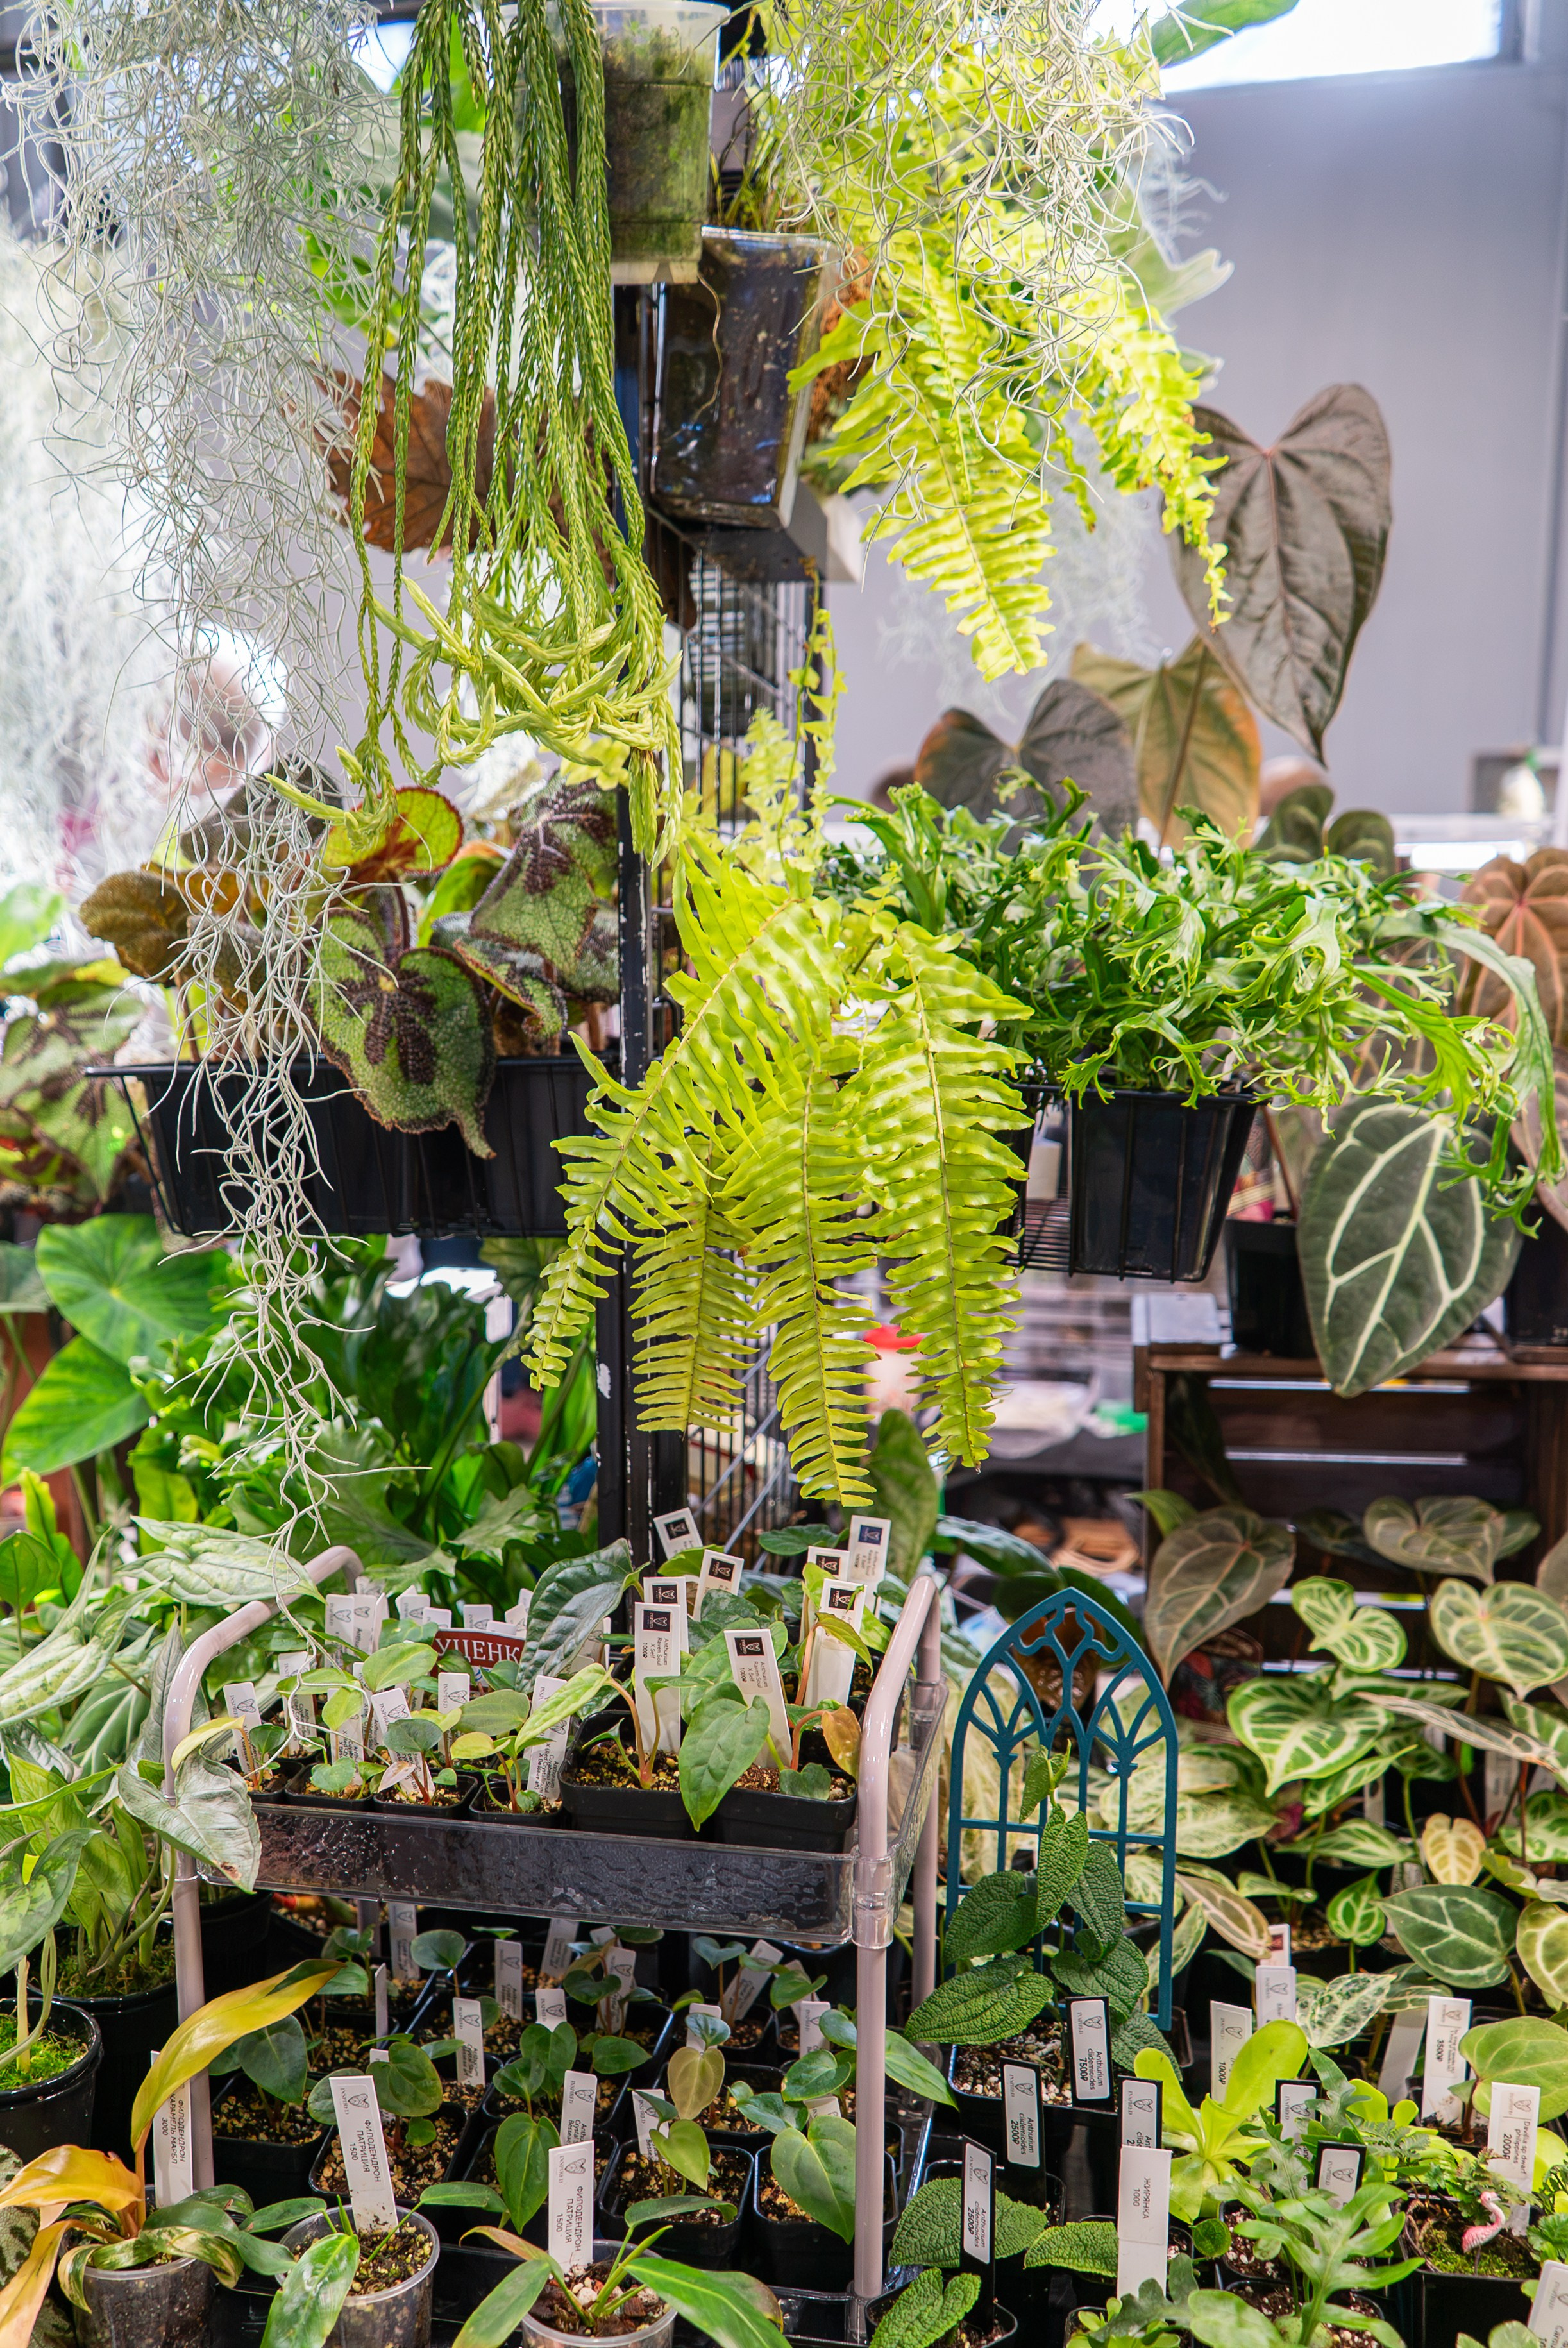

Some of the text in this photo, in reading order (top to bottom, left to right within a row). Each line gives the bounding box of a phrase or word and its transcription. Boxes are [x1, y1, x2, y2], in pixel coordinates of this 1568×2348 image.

[435, 1638, 521, 1664] УЦЕНК
[760, 1661, 769, 1688] Anthurium
[550, 1761, 559, 1788] Anthurium
[1087, 2048, 1096, 2090] clidemioides
[340, 2088, 350, 2115] INSPIRED
[178, 2099, 186, 2162] ФИЛОДЕНДРОН
[573, 2119, 581, 2140] Crystal
[1018, 2113, 1027, 2154] clidemioides
[1027, 2116, 1035, 2153] Anthurium
[1513, 2129, 1522, 2164] philippines
[350, 2143, 358, 2161] 1500
[357, 2130, 371, 2173] ПАТРИЦИЯ
[364, 2119, 382, 2183] ФИЛОДЕНДРОН
[1521, 2145, 1527, 2154] sp
[1133, 2188, 1141, 2207] 1000
[1142, 2177, 1152, 2219] ЖИРЯНКА
[564, 2198, 574, 2243] ПАТРИЦИЯ
[574, 2186, 584, 2252] ФИЛОДЕНДРОН
